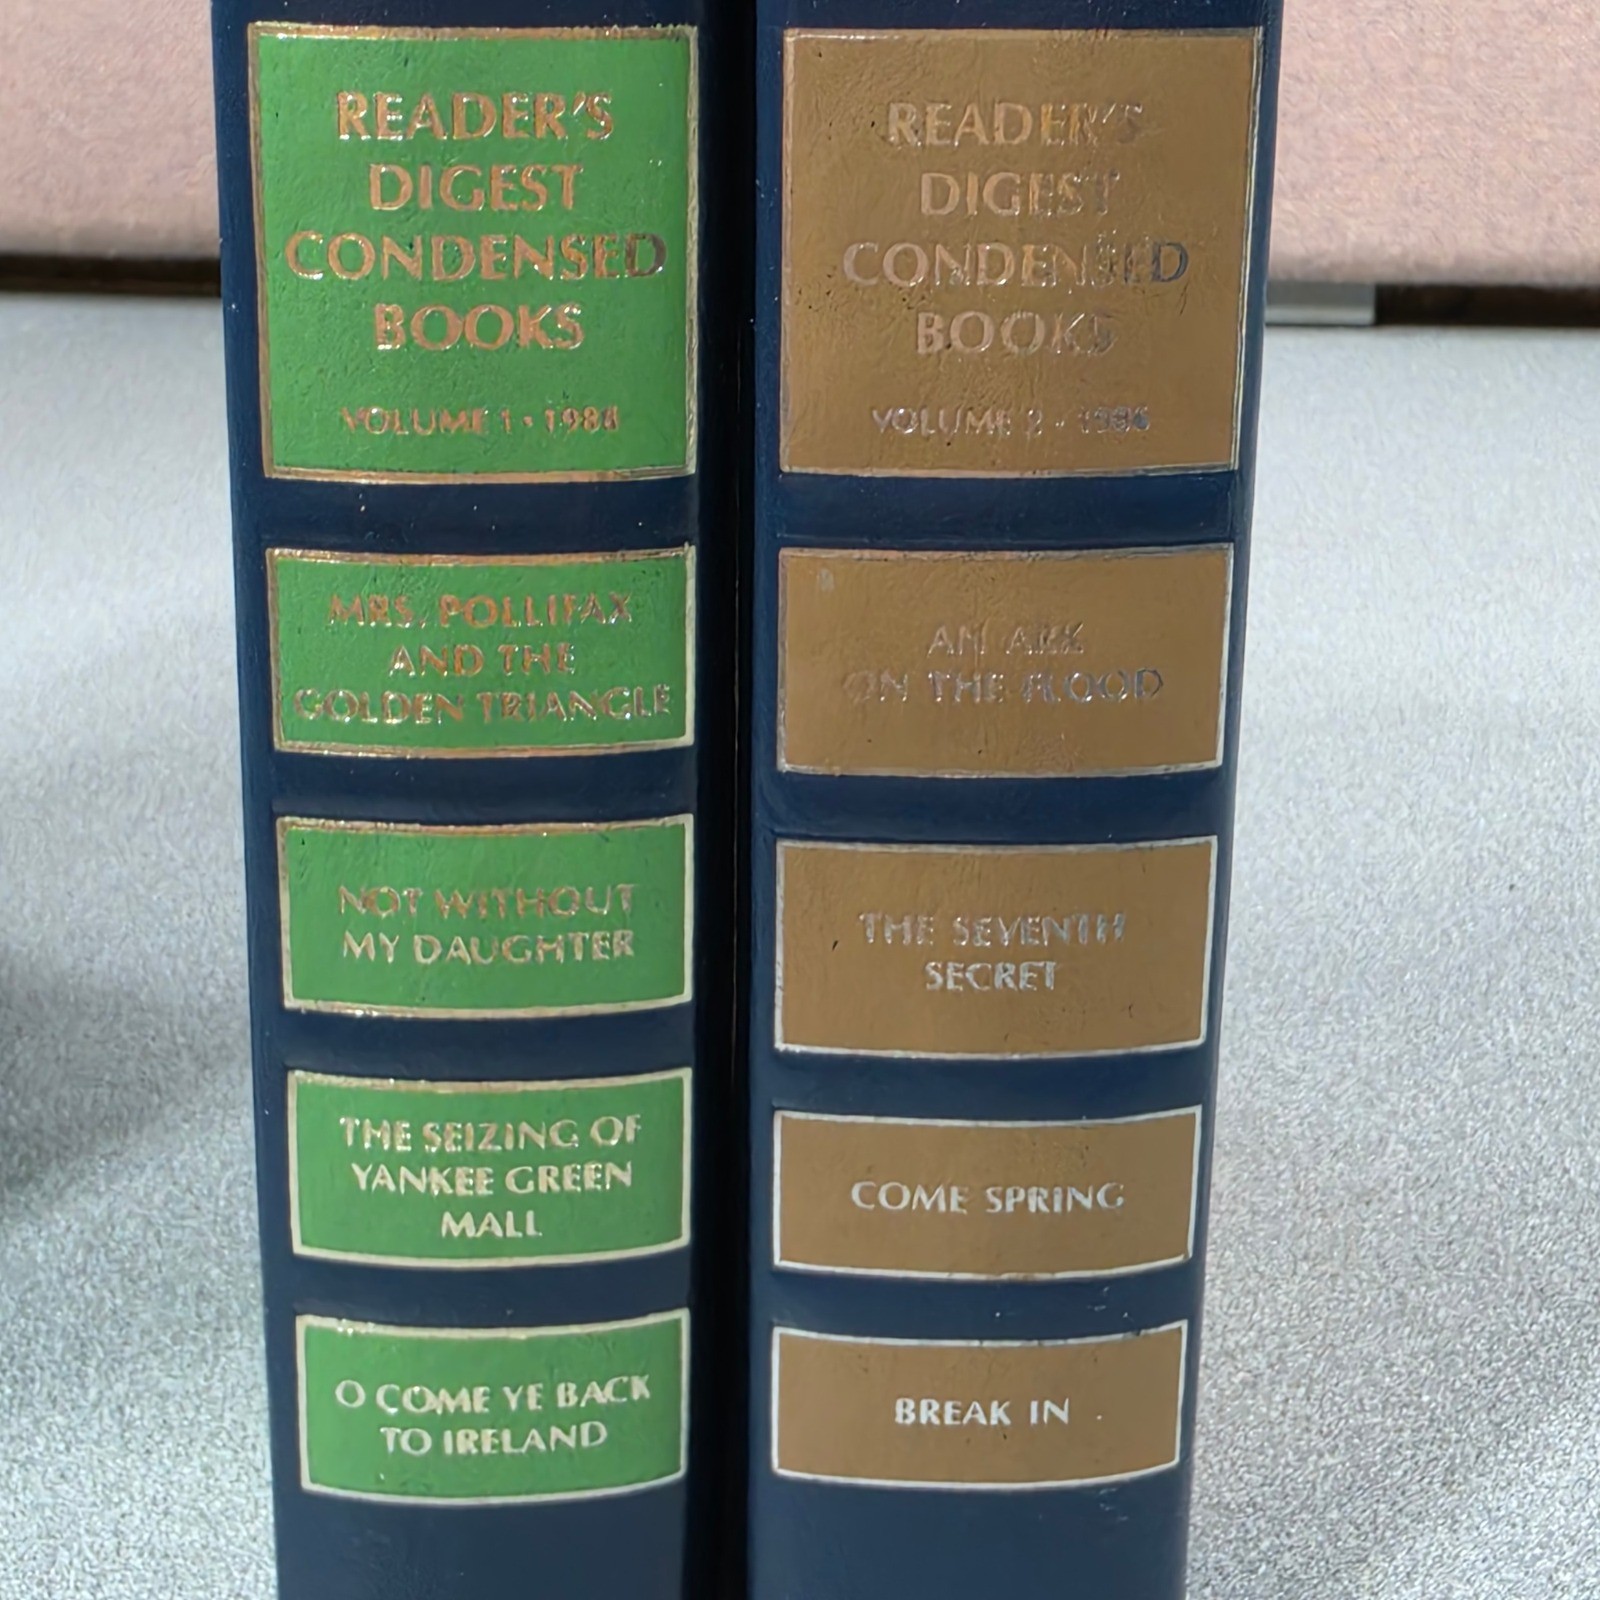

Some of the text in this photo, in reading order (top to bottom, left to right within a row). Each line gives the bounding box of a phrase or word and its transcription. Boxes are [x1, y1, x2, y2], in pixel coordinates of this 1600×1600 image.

[337, 91, 614, 141] READER'S
[369, 163, 583, 211] DIGEST
[921, 170, 1120, 217] DIGEST
[285, 230, 668, 281] CONDENSED
[843, 240, 1190, 287] CONDENSED
[373, 303, 584, 351] BOOKS
[917, 311, 1116, 355] BOOKS
[341, 406, 489, 435] VOLUME
[501, 408, 511, 433] 1
[872, 407, 1011, 436] VOLUME
[328, 594, 633, 628] MRS. POLLIFAX
[928, 624, 986, 655] AN
[389, 643, 576, 676] AND THE
[841, 670, 908, 702] ON
[927, 672, 1005, 702] THE
[293, 684, 671, 724] GOLDEN TRIANGLE
[338, 883, 637, 919] NOT WITHOUT
[342, 929, 635, 964] MY DAUGHTER
[858, 911, 1127, 947] THE SEVENTH
[925, 961, 1061, 992] SECRET
[339, 1113, 642, 1153] THE SEIZING OF
[351, 1161, 633, 1196] YANKEE GREEN
[851, 1181, 1126, 1214] COME SPRING
[441, 1210, 542, 1239] MALL
[335, 1374, 650, 1414] O COME YE BACK
[894, 1397, 1070, 1426] BREAK IN
[379, 1421, 608, 1455] TO IRELAND
